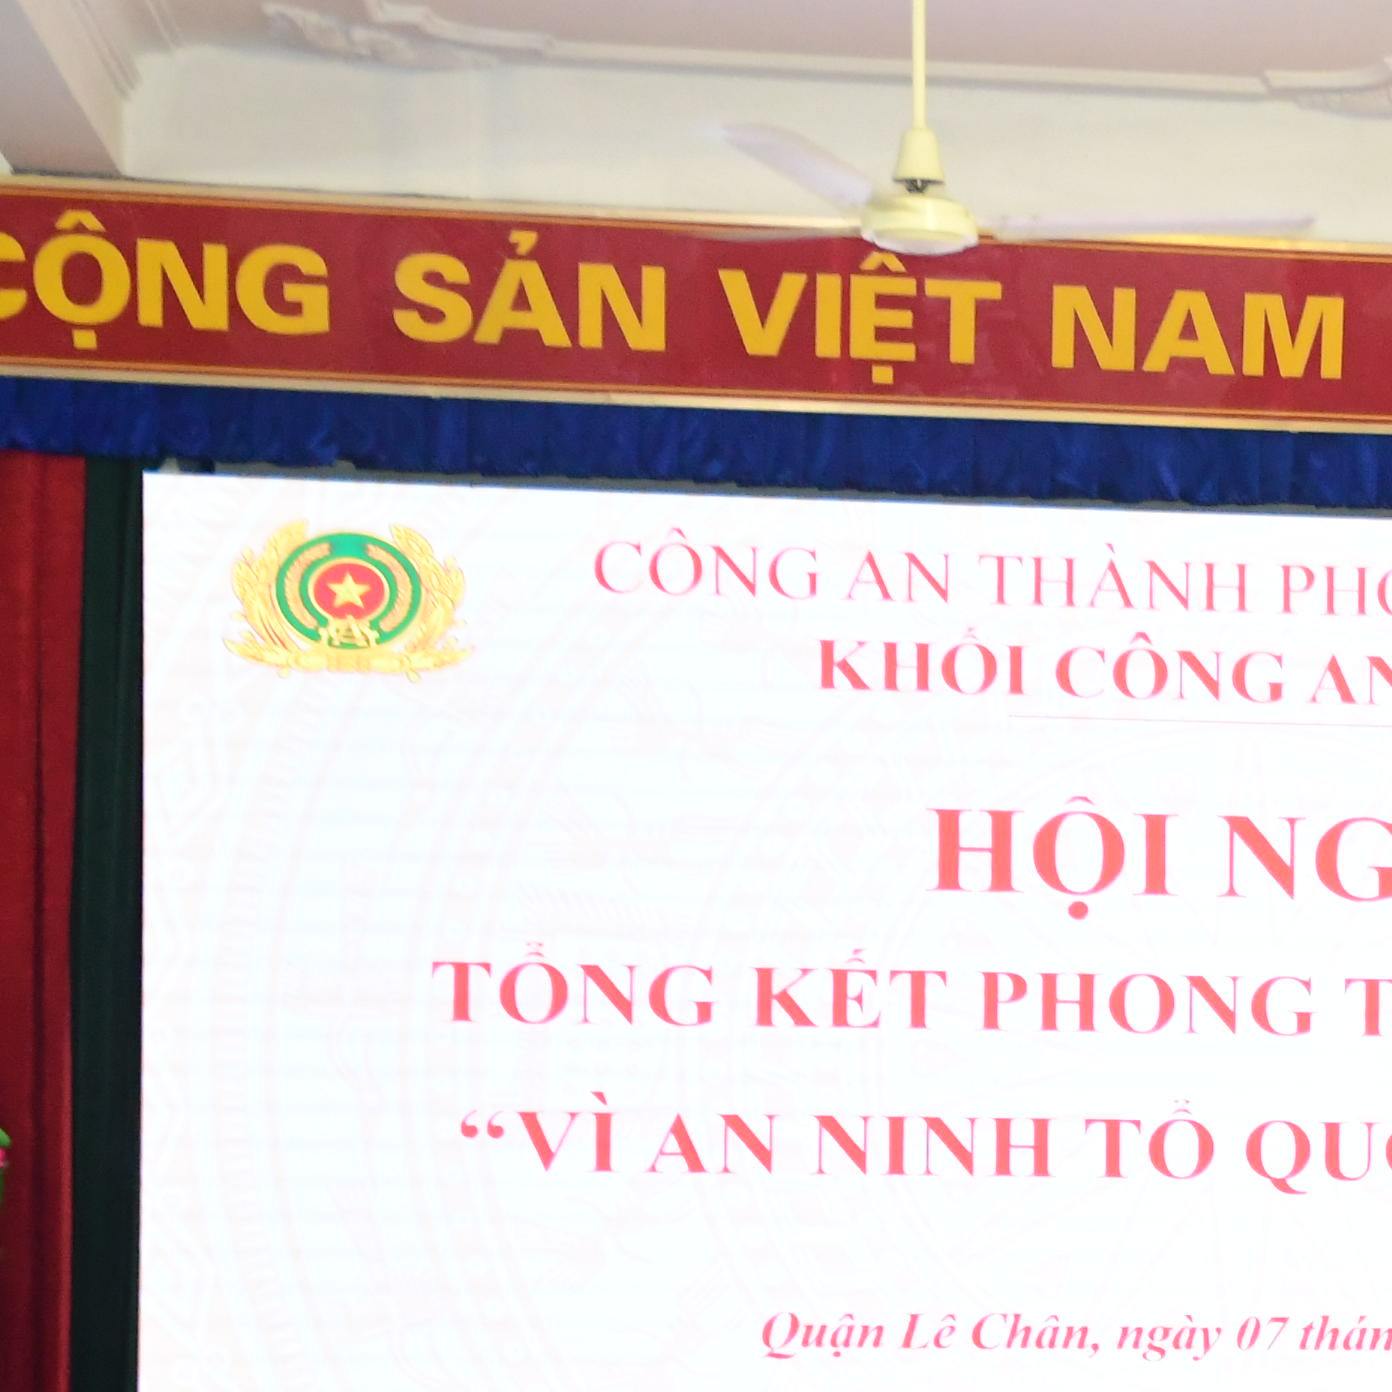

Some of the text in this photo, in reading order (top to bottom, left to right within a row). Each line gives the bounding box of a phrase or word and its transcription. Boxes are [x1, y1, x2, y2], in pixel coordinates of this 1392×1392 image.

[394, 231, 667, 352] SẢN
[718, 252, 1002, 385] VIỆT
[1052, 285, 1345, 379] NAM
[592, 526, 820, 600] CÔNG
[841, 550, 951, 604] AN
[977, 542, 1250, 613] THÀNH
[817, 626, 1026, 696] KHỐI
[1053, 631, 1286, 704] CÔNG
[926, 795, 1179, 921] HỘI
[430, 941, 717, 1027] TỔNG
[751, 947, 949, 1030] KẾT
[979, 970, 1315, 1037] PHONG
[645, 1111, 781, 1175] AN
[813, 1114, 1054, 1178] NINH
[760, 1312, 886, 1360] Quận
[899, 1313, 958, 1350] Lê
[970, 1312, 1101, 1358] Chân,
[1115, 1314, 1224, 1361] ngày
[1235, 1316, 1292, 1350] 07
